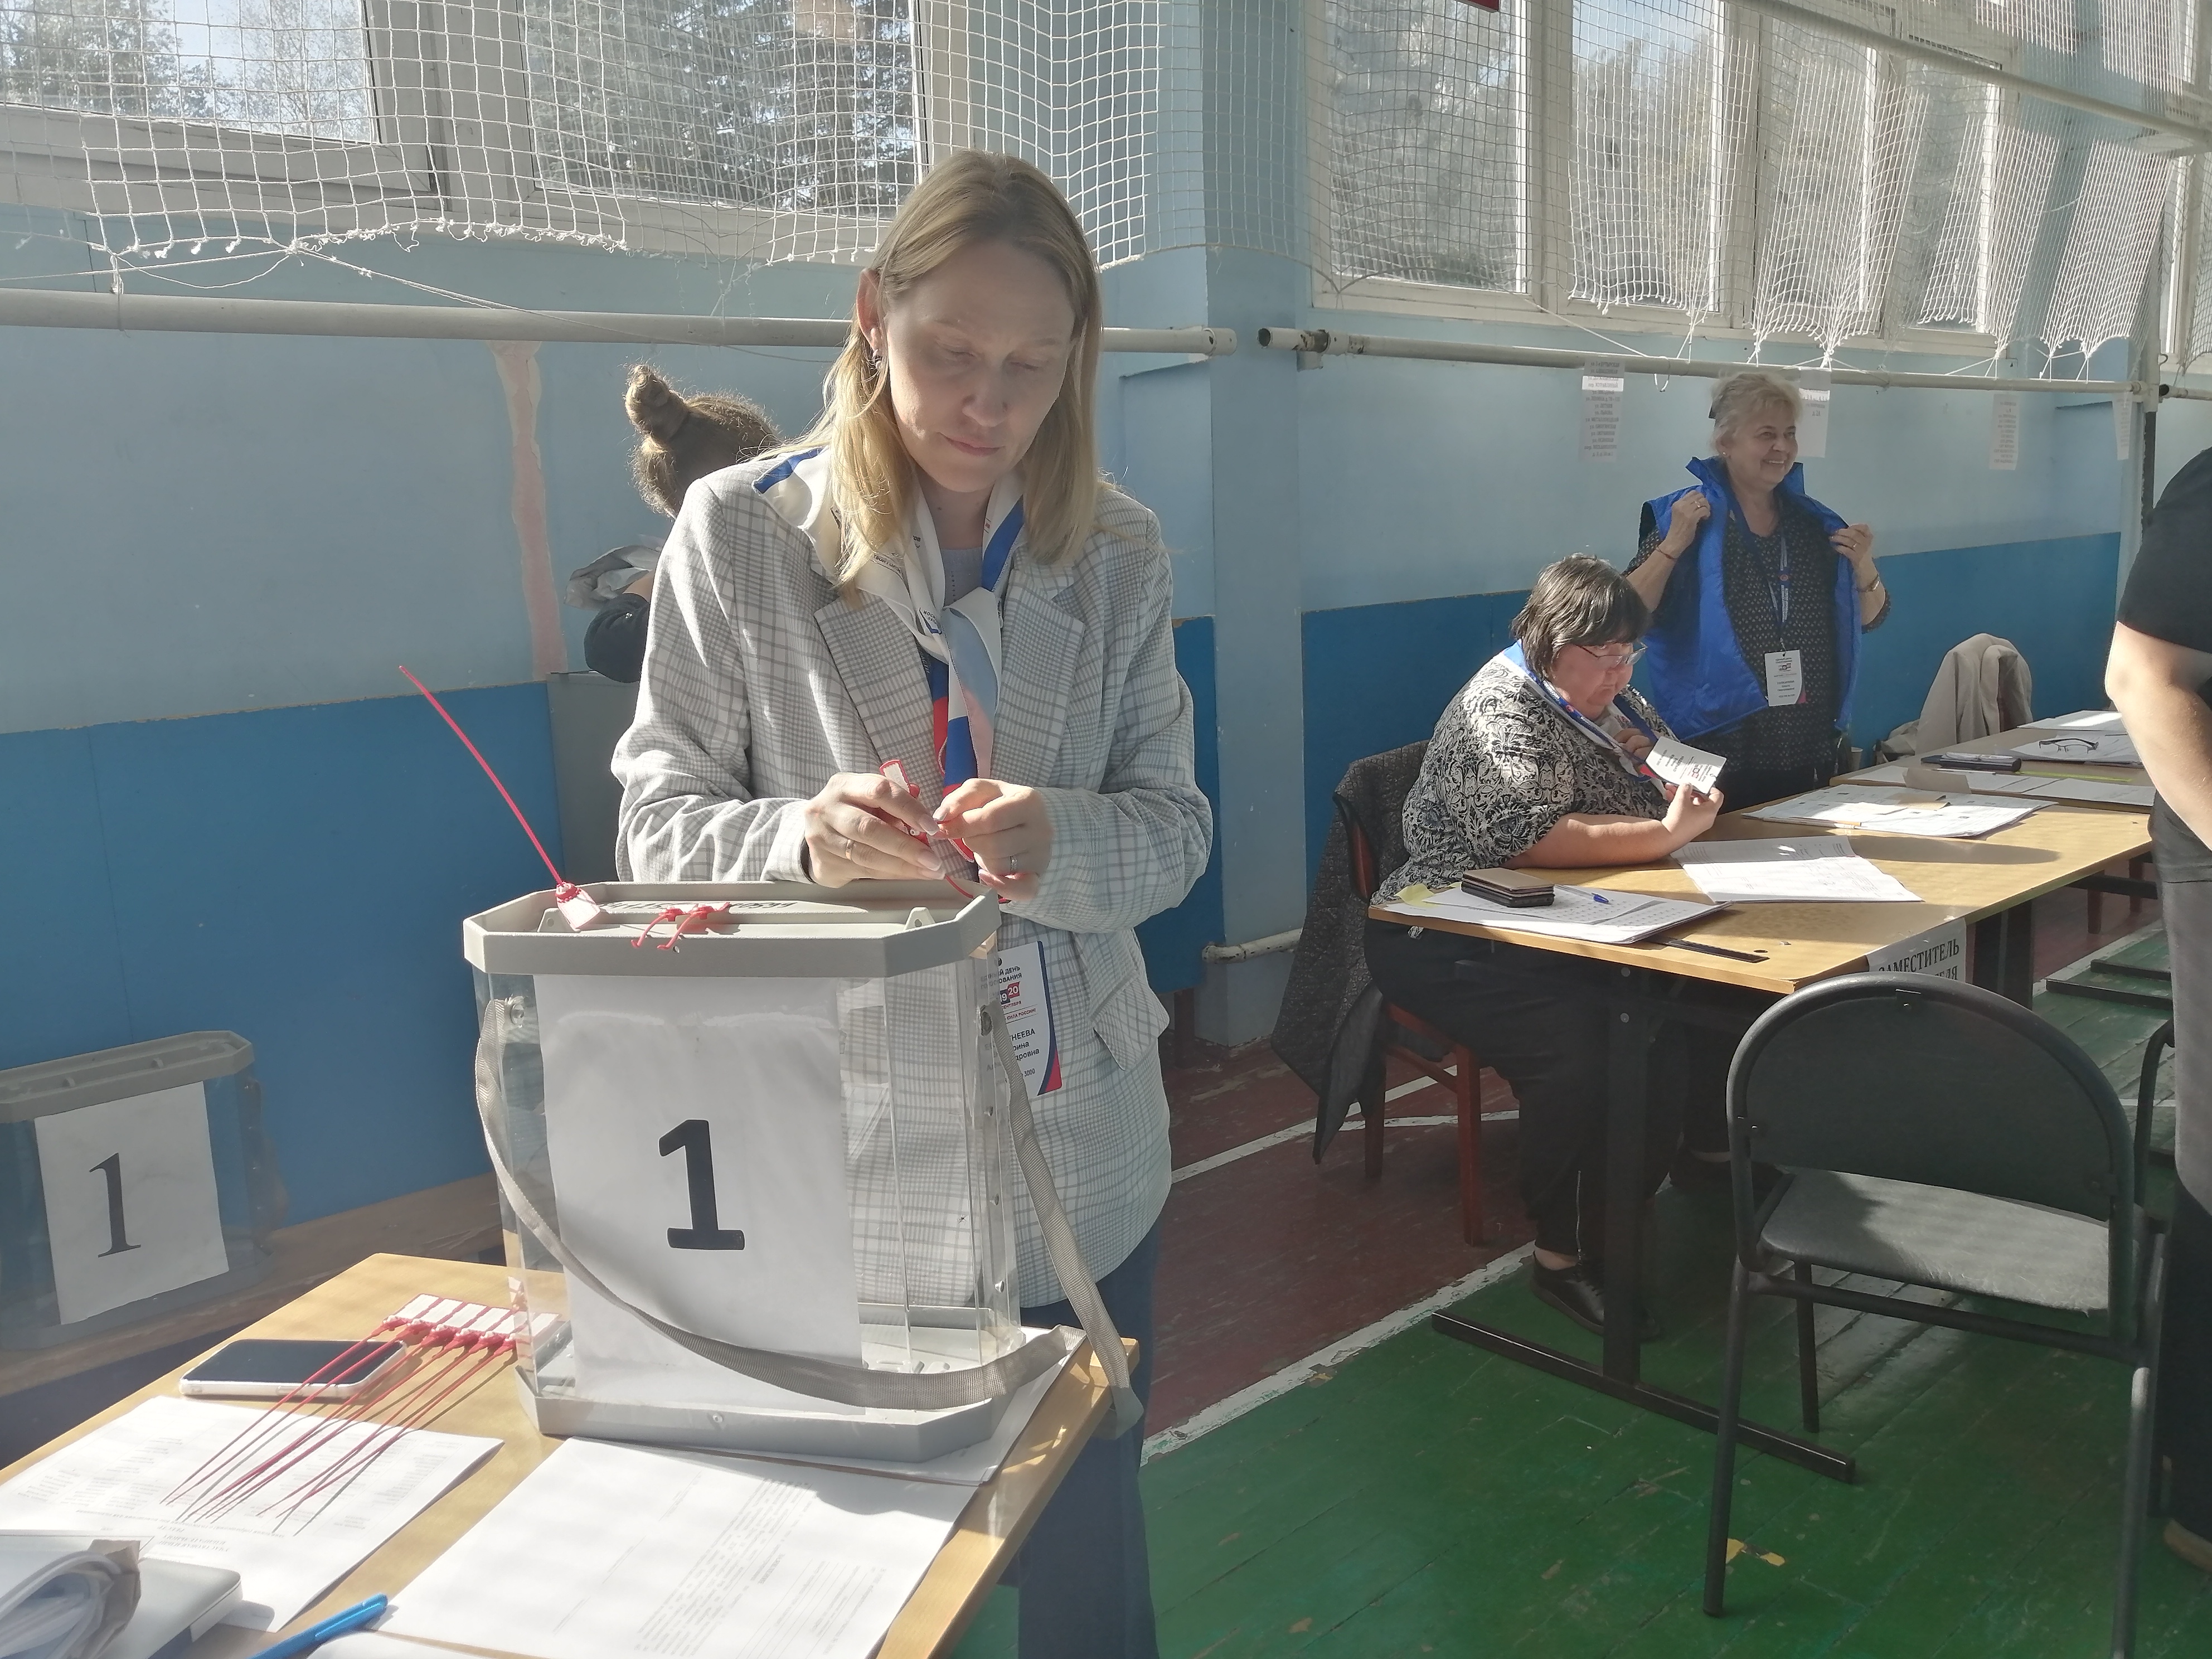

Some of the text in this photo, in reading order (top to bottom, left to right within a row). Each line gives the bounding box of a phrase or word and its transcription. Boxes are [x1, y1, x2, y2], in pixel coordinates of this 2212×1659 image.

[1005, 966, 1021, 975] ДЕНЬ
[1007, 985, 1019, 996] 20
[1001, 1001, 1022, 1010] ЕНТЯБРЯ
[1010, 1028, 1036, 1041] НЕЕВА
[658, 1119, 745, 1250] 1
[89, 1152, 142, 1258] 1
